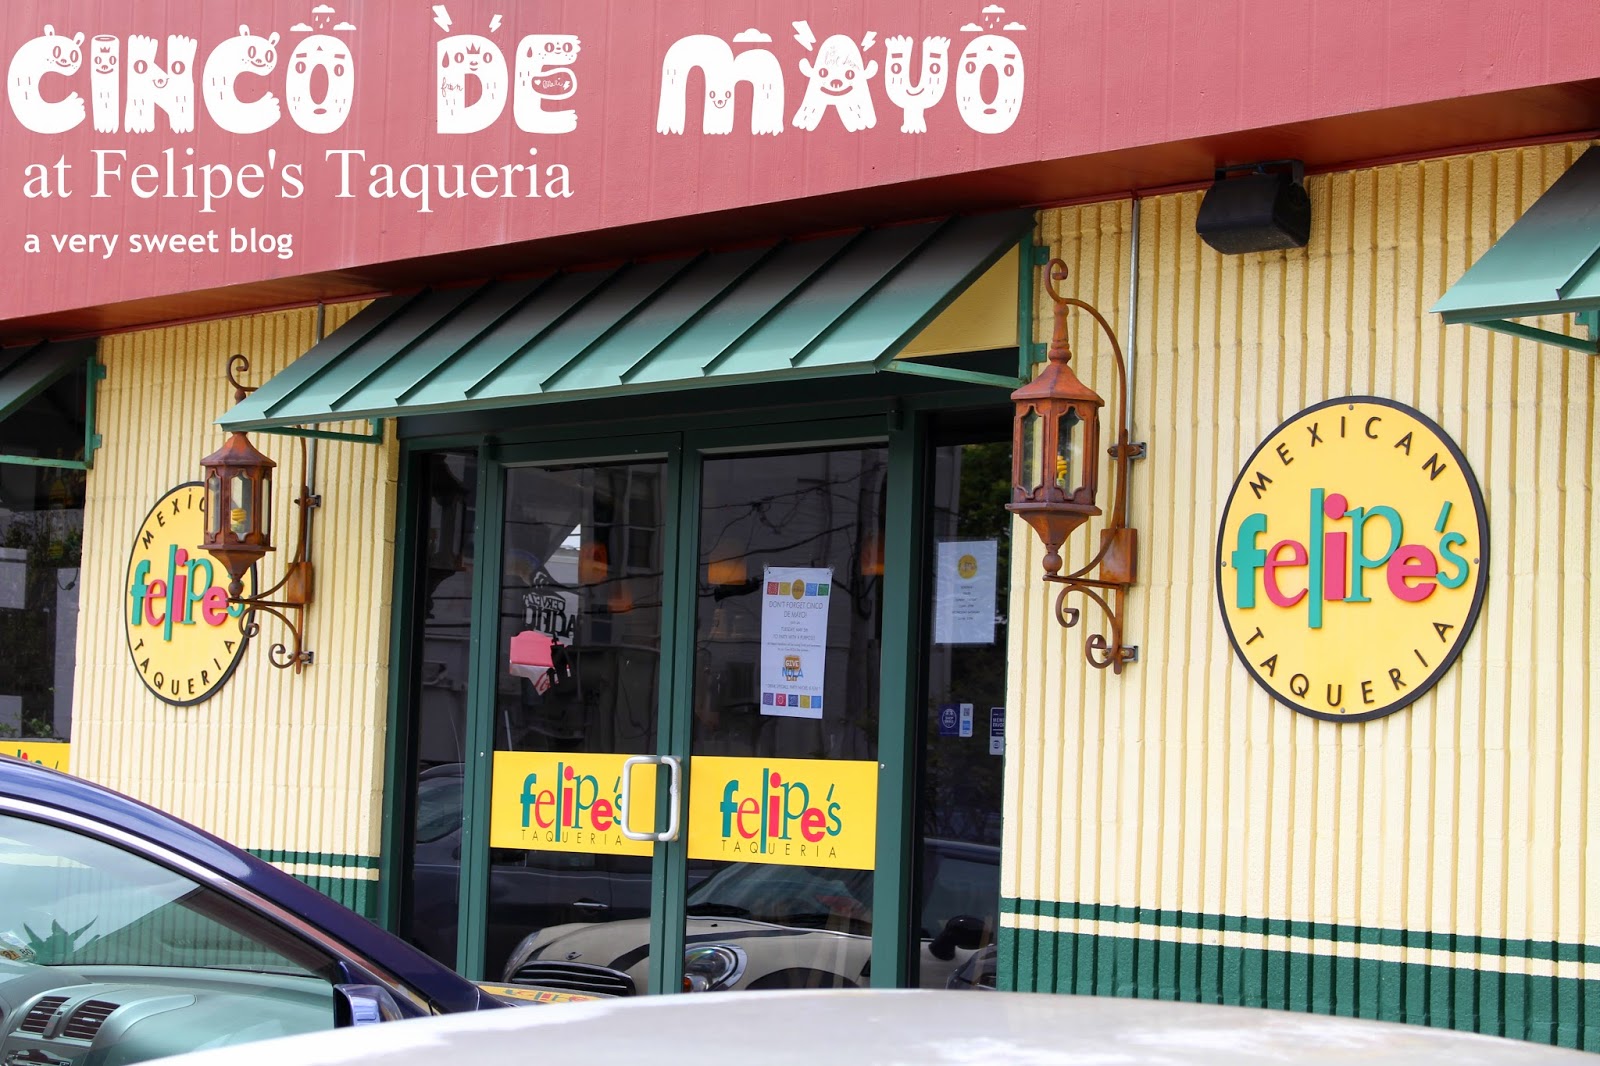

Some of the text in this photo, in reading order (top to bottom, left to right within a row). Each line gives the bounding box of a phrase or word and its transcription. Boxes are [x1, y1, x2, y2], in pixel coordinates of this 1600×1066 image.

[1248, 415, 1447, 500] MEXICAN
[142, 494, 206, 550] MEXI
[1231, 487, 1470, 630] felipe's
[130, 543, 246, 642] felipe
[133, 637, 236, 696] TAQUERIA
[785, 659, 800, 667] GIVE
[1245, 621, 1454, 707] TAQUERIA
[519, 761, 623, 843] felipe's
[520, 828, 623, 846] TAQUERIA
[719, 767, 843, 855] felipe's
[721, 839, 838, 860] TAQUERIA
